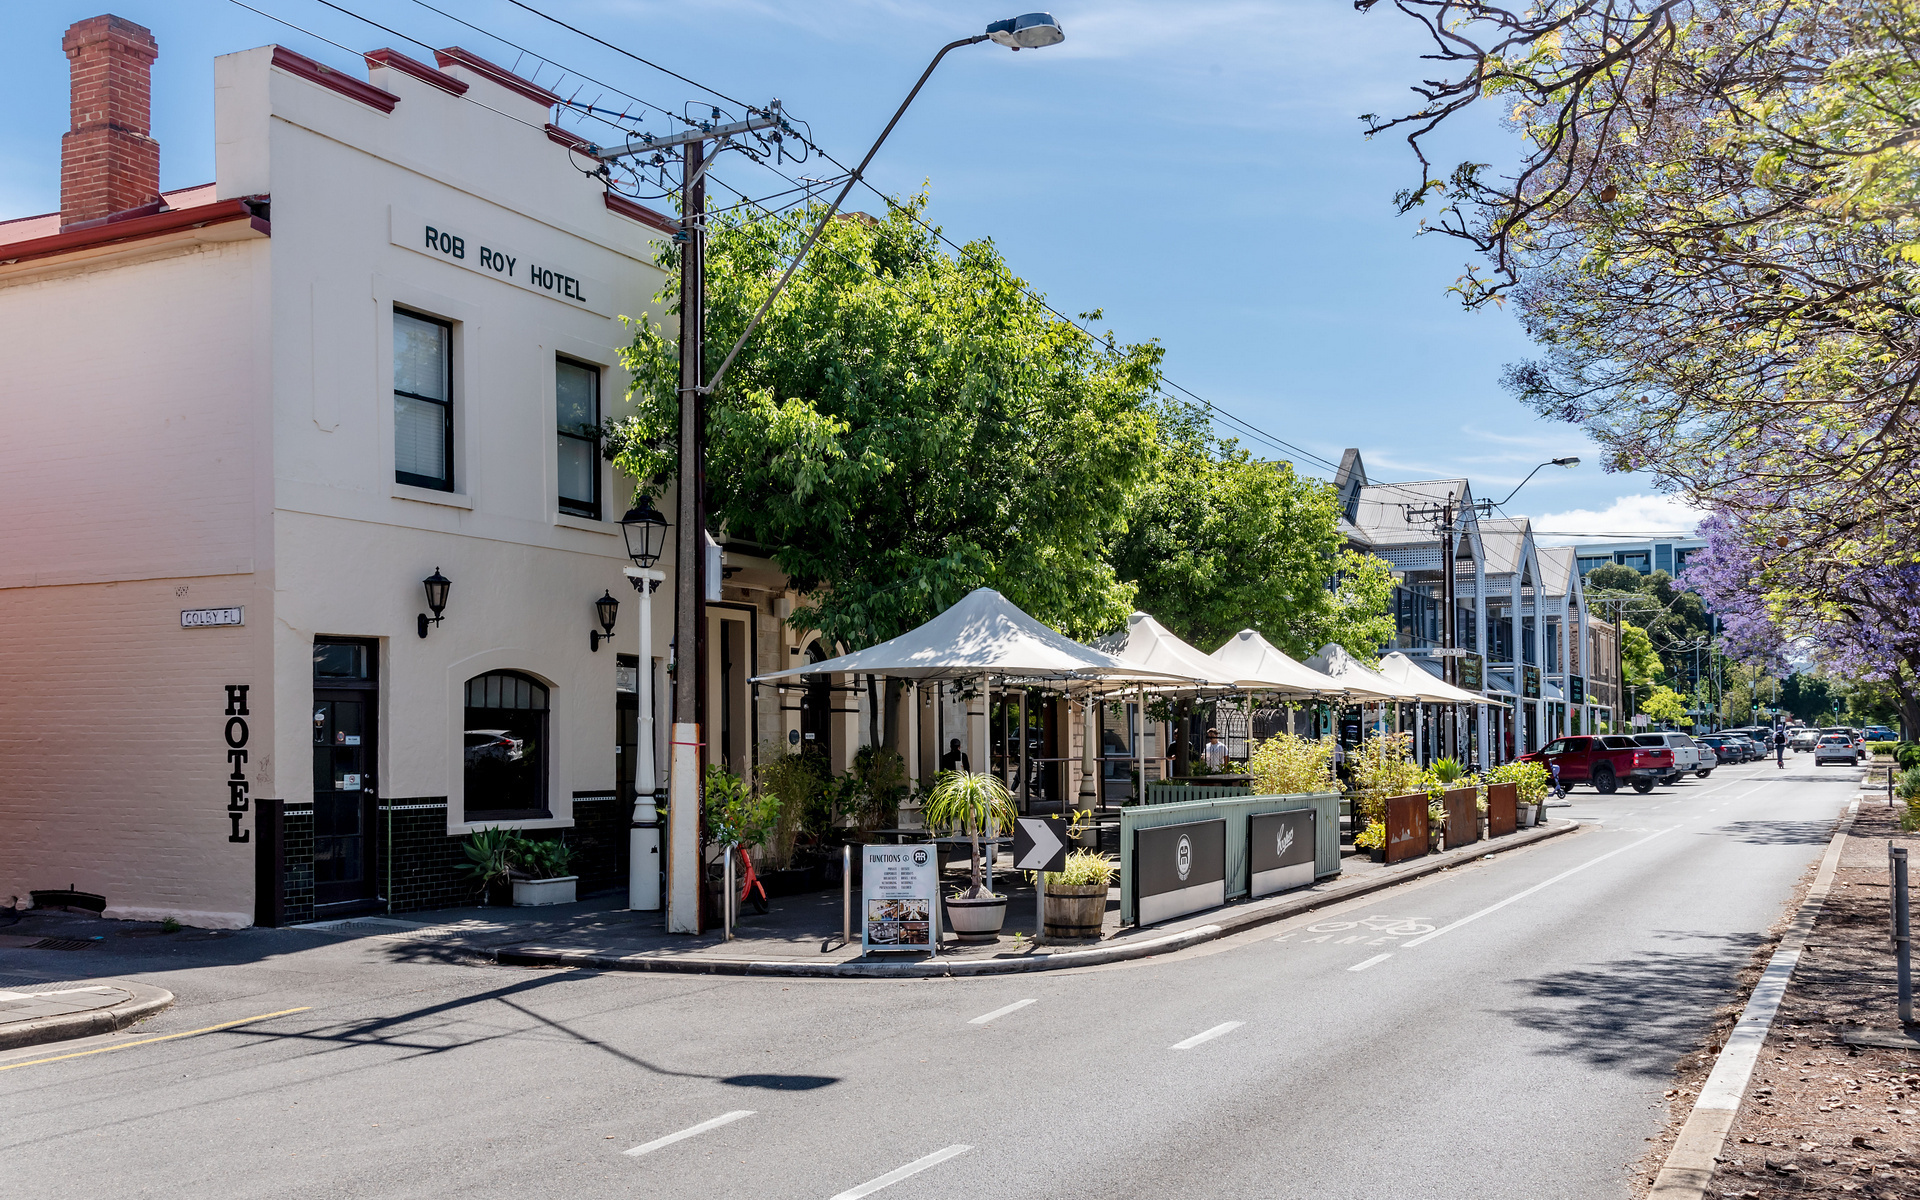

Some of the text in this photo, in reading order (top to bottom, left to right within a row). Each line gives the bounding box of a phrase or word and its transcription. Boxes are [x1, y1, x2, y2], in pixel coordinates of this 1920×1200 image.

[425, 225, 587, 303] ROB ROY HOTEL
[185, 611, 219, 624] COLBY
[224, 684, 250, 843] HOTEL
[869, 854, 901, 863] FUNCTIONS
